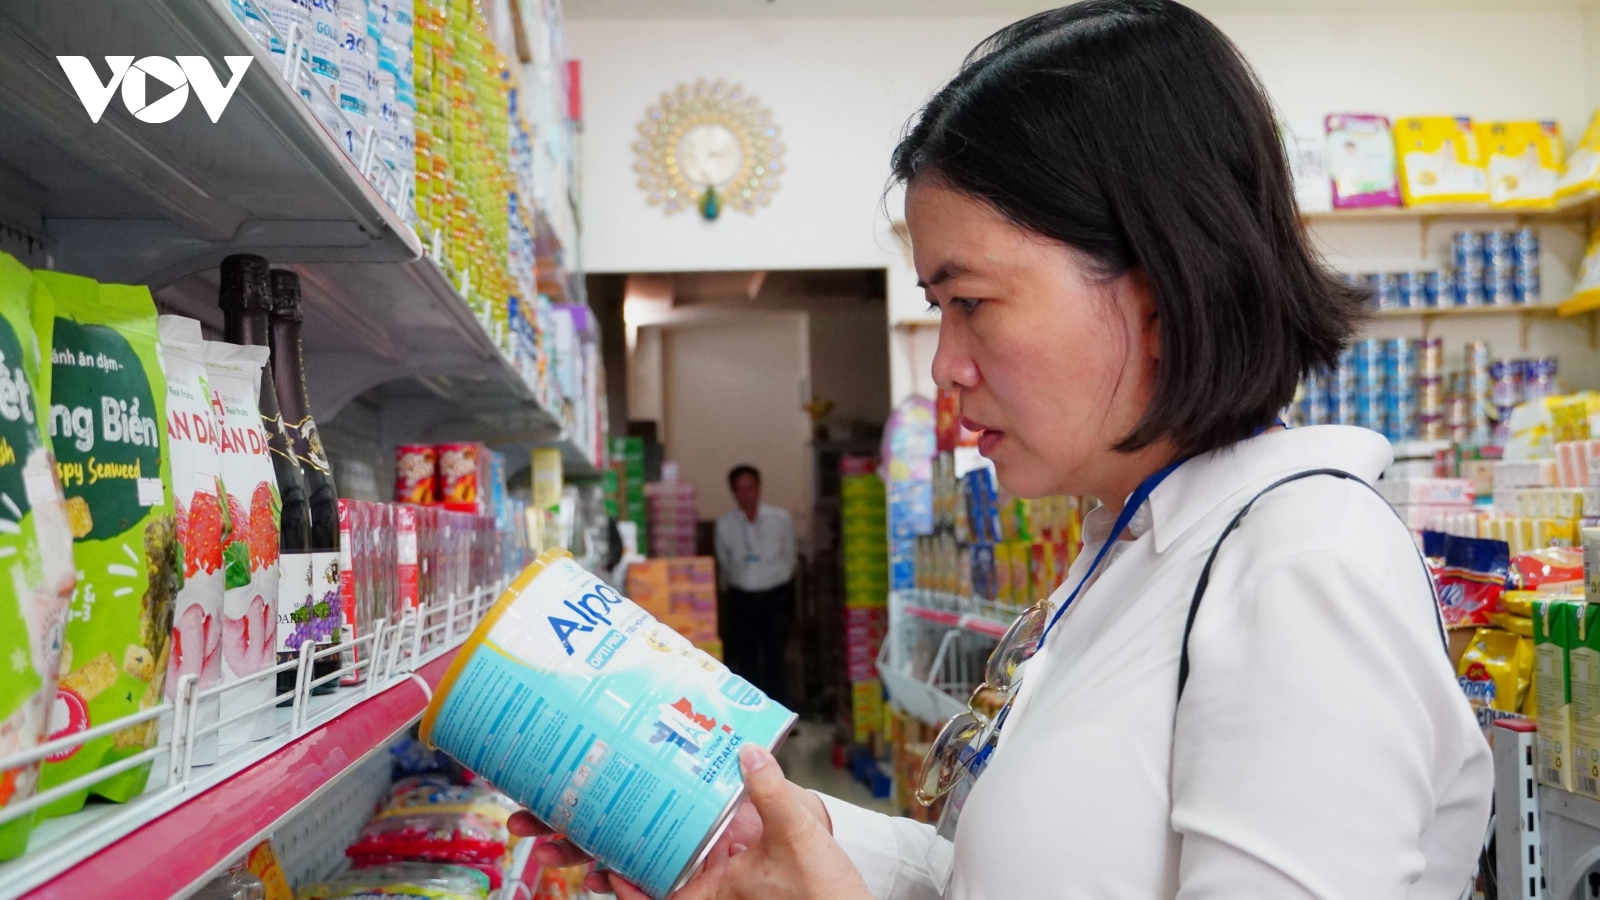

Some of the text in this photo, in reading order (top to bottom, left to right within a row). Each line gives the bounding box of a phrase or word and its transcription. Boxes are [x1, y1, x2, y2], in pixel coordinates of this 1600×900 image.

[101, 394, 159, 448] Biển
[88, 455, 142, 485] Seaweed
[589, 630, 623, 668] OPTI PRO
[702, 732, 742, 783] EN FRANCE
